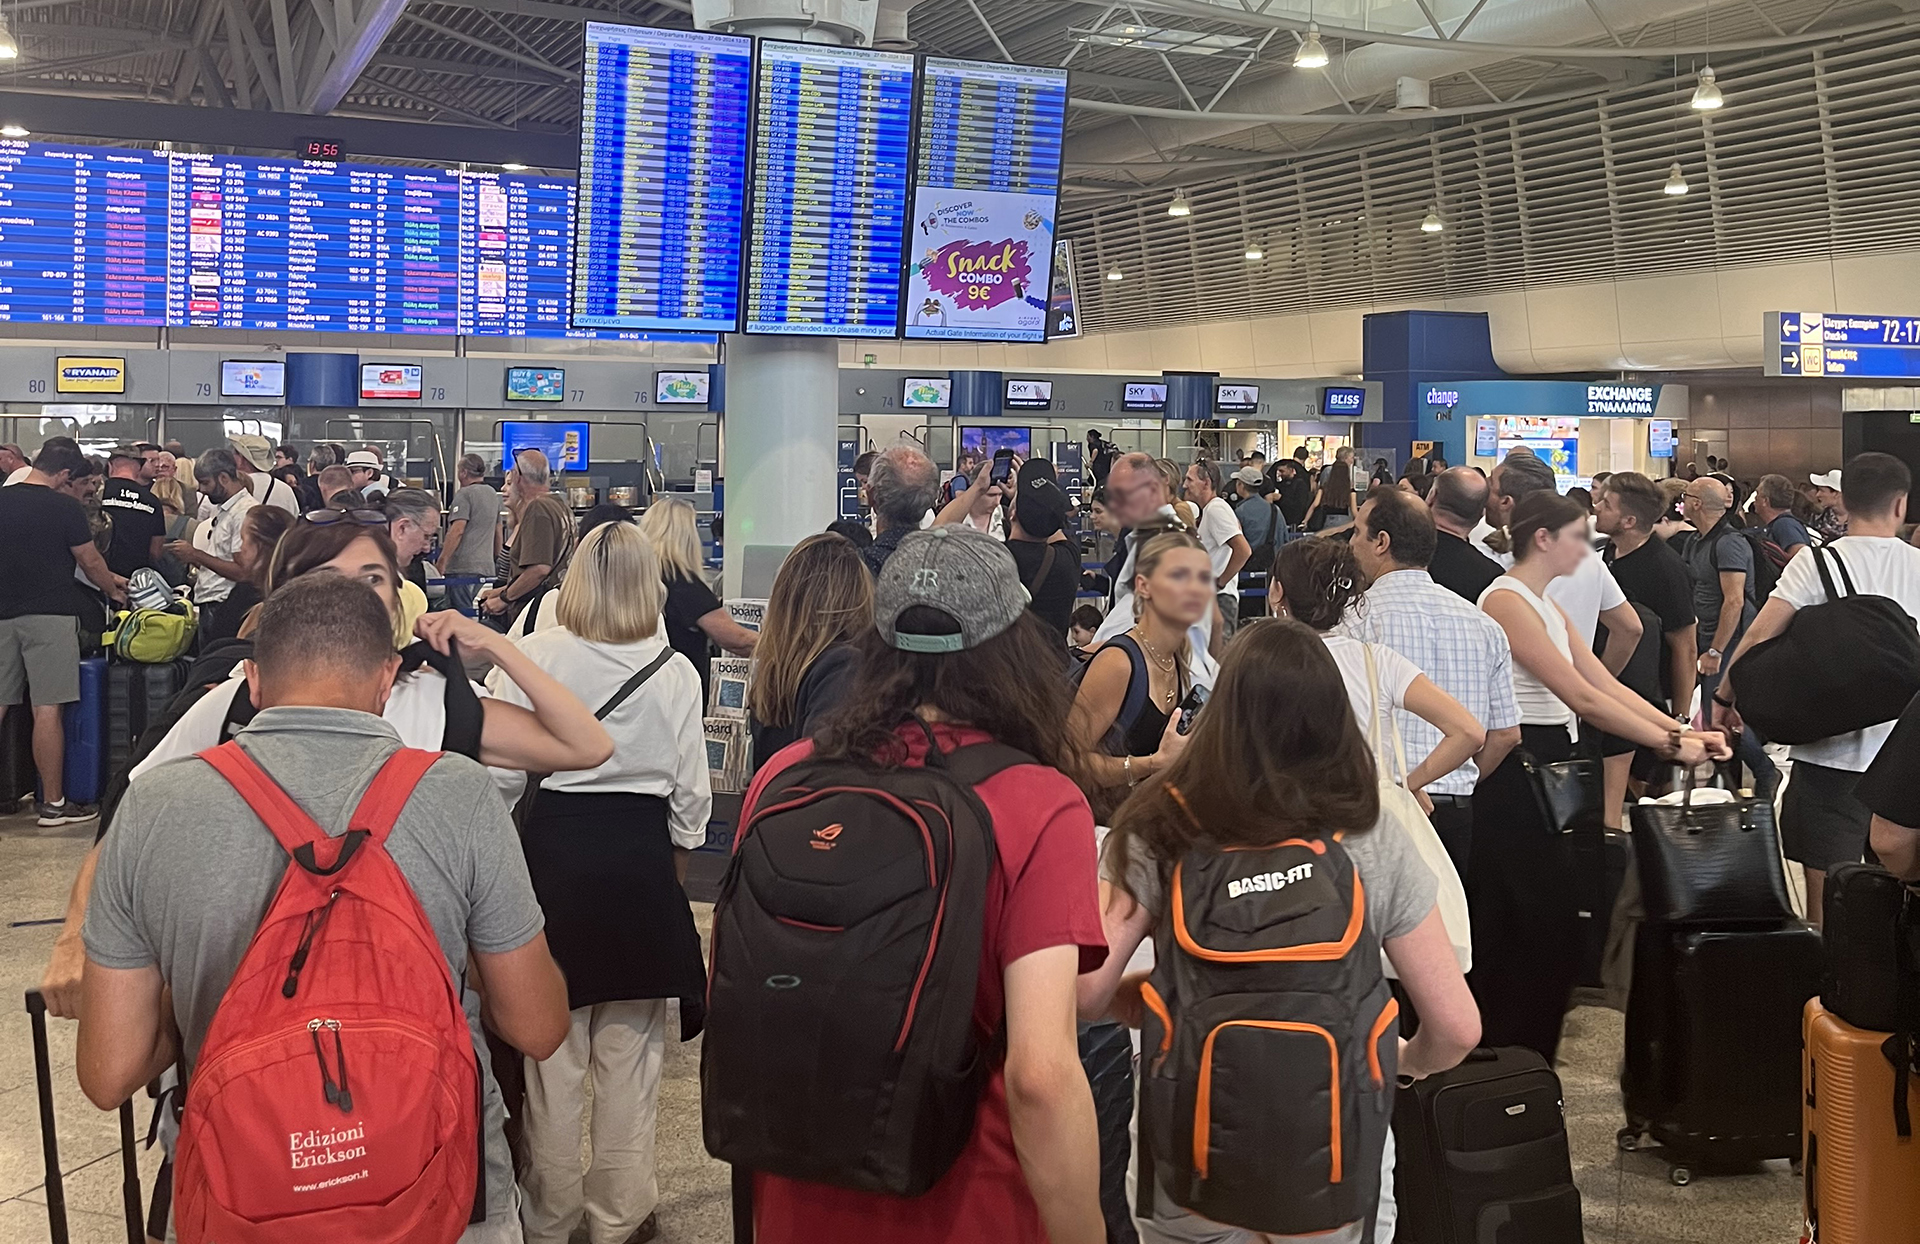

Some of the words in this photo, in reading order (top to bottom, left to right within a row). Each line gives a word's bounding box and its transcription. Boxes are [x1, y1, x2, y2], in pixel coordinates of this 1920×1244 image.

[657, 30, 684, 38] Departure
[938, 201, 973, 216] DISCOVER
[947, 244, 1017, 278] Snack
[958, 273, 1003, 284] COMBO
[968, 285, 991, 300] 9€
[1806, 355, 1818, 365] WC
[72, 368, 117, 377] RYANAIR
[29, 380, 45, 393] 80
[196, 383, 211, 396] 79
[431, 388, 445, 400] 78
[571, 390, 584, 402] 77
[634, 392, 647, 403] 76
[1331, 394, 1359, 404] BLISS
[1427, 388, 1458, 408] change
[1588, 386, 1652, 401] EXCHANGE
[882, 397, 893, 407] 74
[1055, 400, 1066, 411] 73
[1103, 401, 1114, 412] 72
[1588, 401, 1652, 413] ΣΥΝΑΛΛΑΓΜΑ
[1261, 404, 1270, 414] 71
[1305, 405, 1315, 415] 70
[731, 606, 761, 617] board
[719, 662, 748, 673] board
[1227, 862, 1314, 899] BASIC-FIT
[290, 1122, 365, 1151] Edizioni
[290, 1145, 366, 1170] Erickson
[293, 1170, 369, 1192] www.erickson.it
